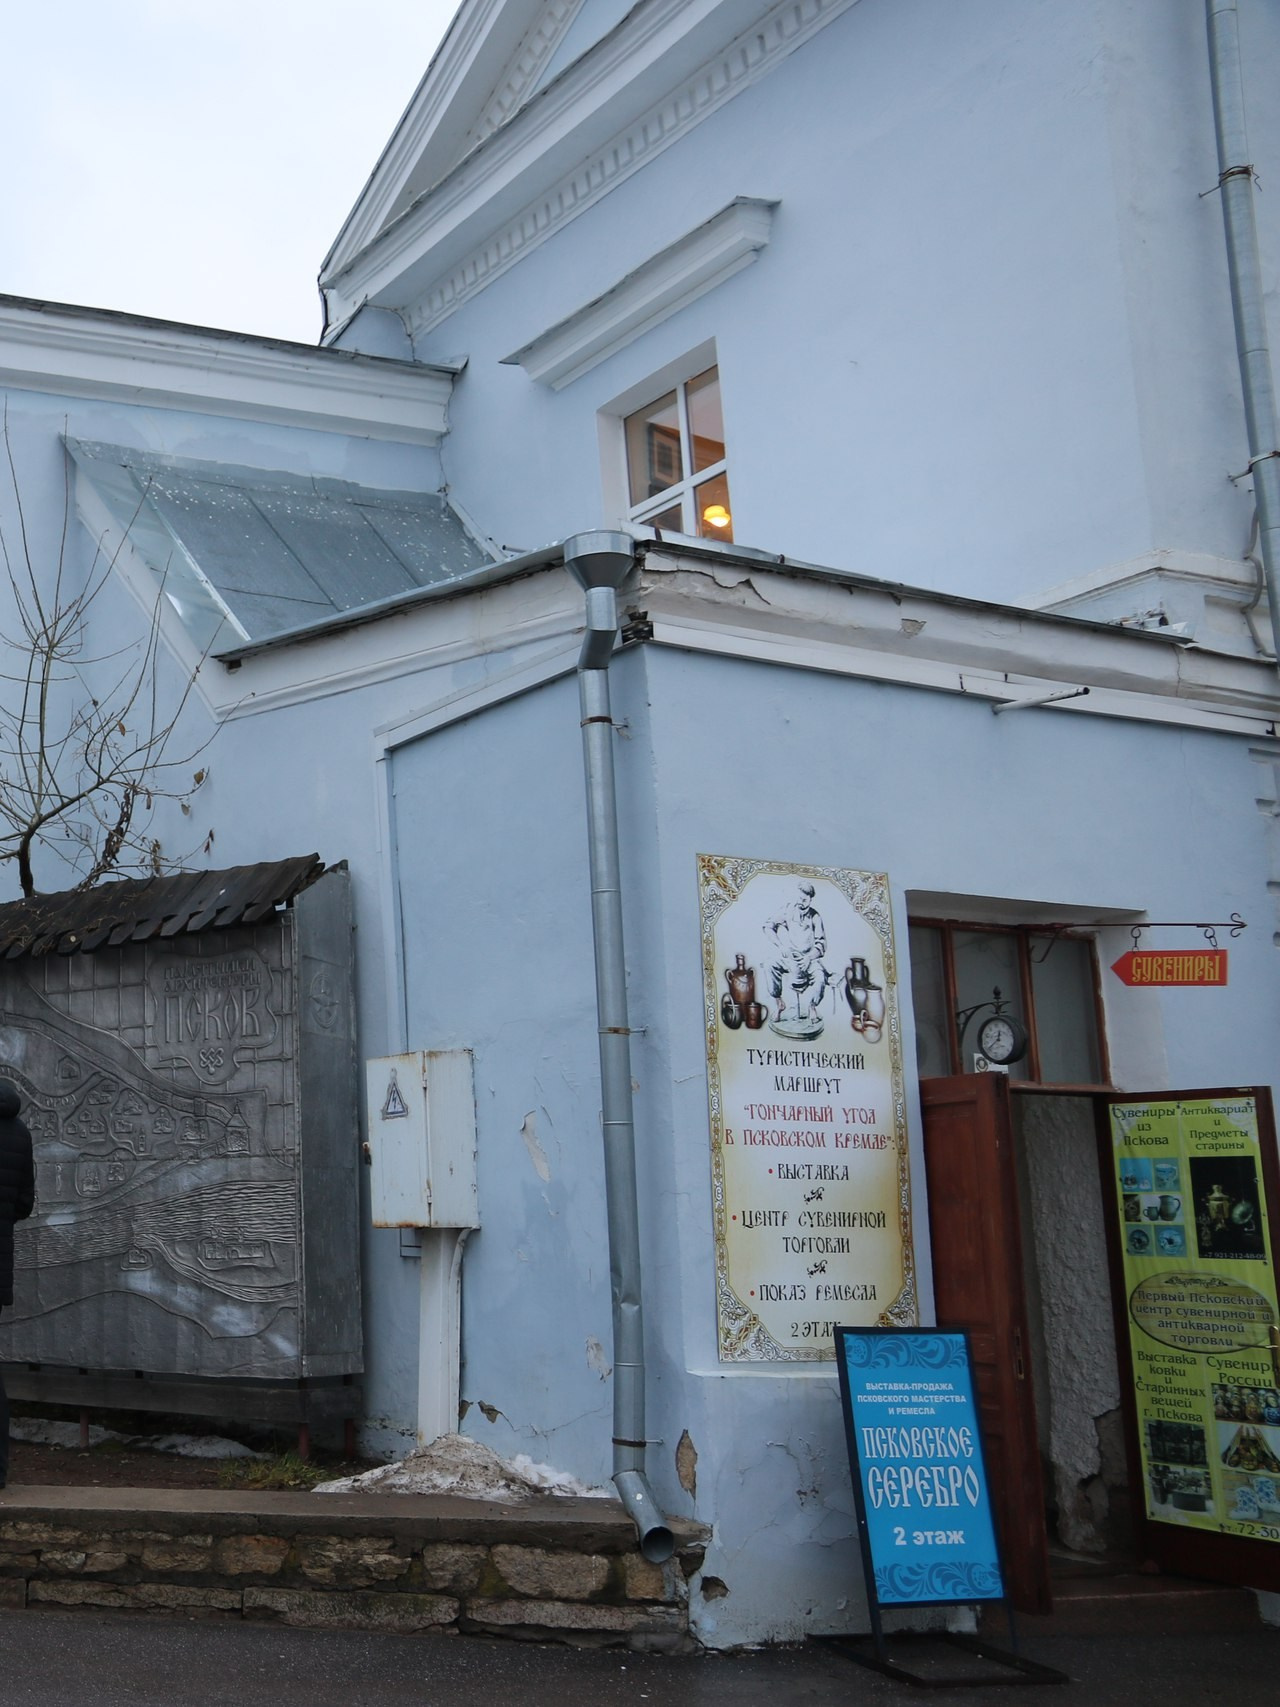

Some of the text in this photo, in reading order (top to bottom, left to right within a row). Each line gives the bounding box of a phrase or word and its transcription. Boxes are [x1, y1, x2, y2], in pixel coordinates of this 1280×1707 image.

[1132, 956, 1220, 982] СУВЕНИРЫ
[746, 1048, 865, 1070] ТУРИСТИЧЕСКИЙ
[774, 1075, 842, 1094] МАРШРУТ
[842, 1107, 876, 1124] УГОЛ
[1112, 1108, 1176, 1120] Сувениры
[1180, 1106, 1256, 1116] Антиквариат
[1138, 1123, 1152, 1132] из
[1190, 1130, 1248, 1140] Предметы
[725, 1128, 734, 1145] В
[744, 1129, 826, 1148] ПСКОВСКОМ
[1124, 1136, 1169, 1146] Пскова
[1196, 1142, 1244, 1152] старины
[778, 1164, 849, 1181] ВЫСТАВКА
[742, 1210, 886, 1228] ЦЕНТР СУВЕНИРНОЙ
[782, 1236, 850, 1254] ТОРГОВЛИ
[760, 1284, 877, 1302] ПОКАЗ РЕМЕСЛА
[1138, 1290, 1265, 1306] Первый Псковский
[1136, 1306, 1172, 1316] центр
[1176, 1306, 1255, 1320] сувенирной
[791, 1322, 799, 1338] 2
[1158, 1320, 1244, 1334] антикварной
[1172, 1334, 1233, 1346] торговли
[1137, 1350, 1197, 1365] Выставка
[1206, 1356, 1272, 1374] Сувенир
[1149, 1364, 1186, 1377] ковки
[866, 1382, 954, 1392] ВЫСТАВКА-ПРОДАЖА
[1218, 1372, 1272, 1388] России
[1136, 1380, 1206, 1397] Старинных
[857, 1395, 910, 1403] ПСКОВСКОГО
[1151, 1396, 1192, 1408] вещей
[1157, 1408, 1203, 1422] Пскова
[862, 1426, 974, 1459] ПСКОВСКОЕ
[868, 1464, 980, 1508] СЕРЕБРО
[893, 1526, 966, 1546] 2 этаж
